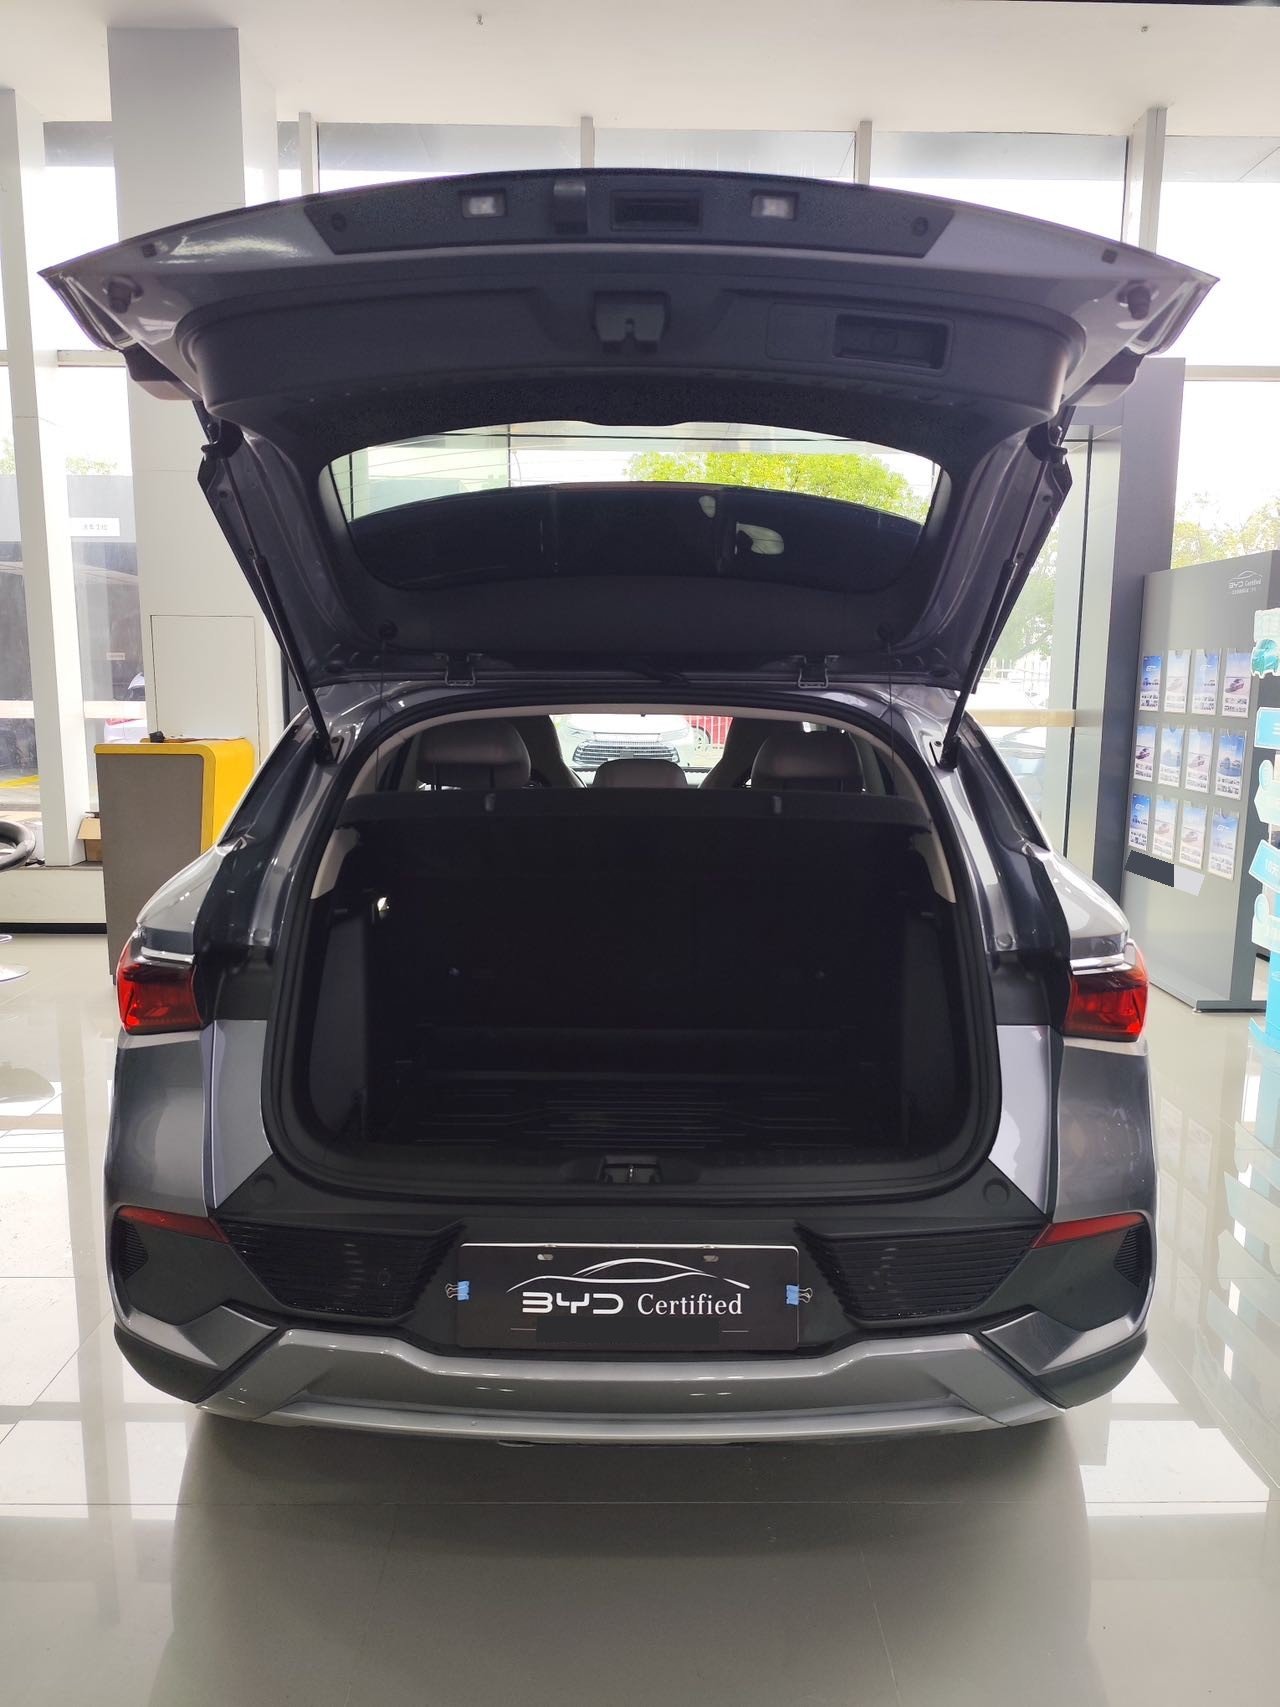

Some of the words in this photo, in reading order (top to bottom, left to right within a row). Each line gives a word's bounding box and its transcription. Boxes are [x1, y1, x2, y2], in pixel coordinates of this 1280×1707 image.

[1229, 581, 1244, 589] BYD
[522, 1291, 624, 1315] BYD
[637, 1293, 743, 1316] Certified
